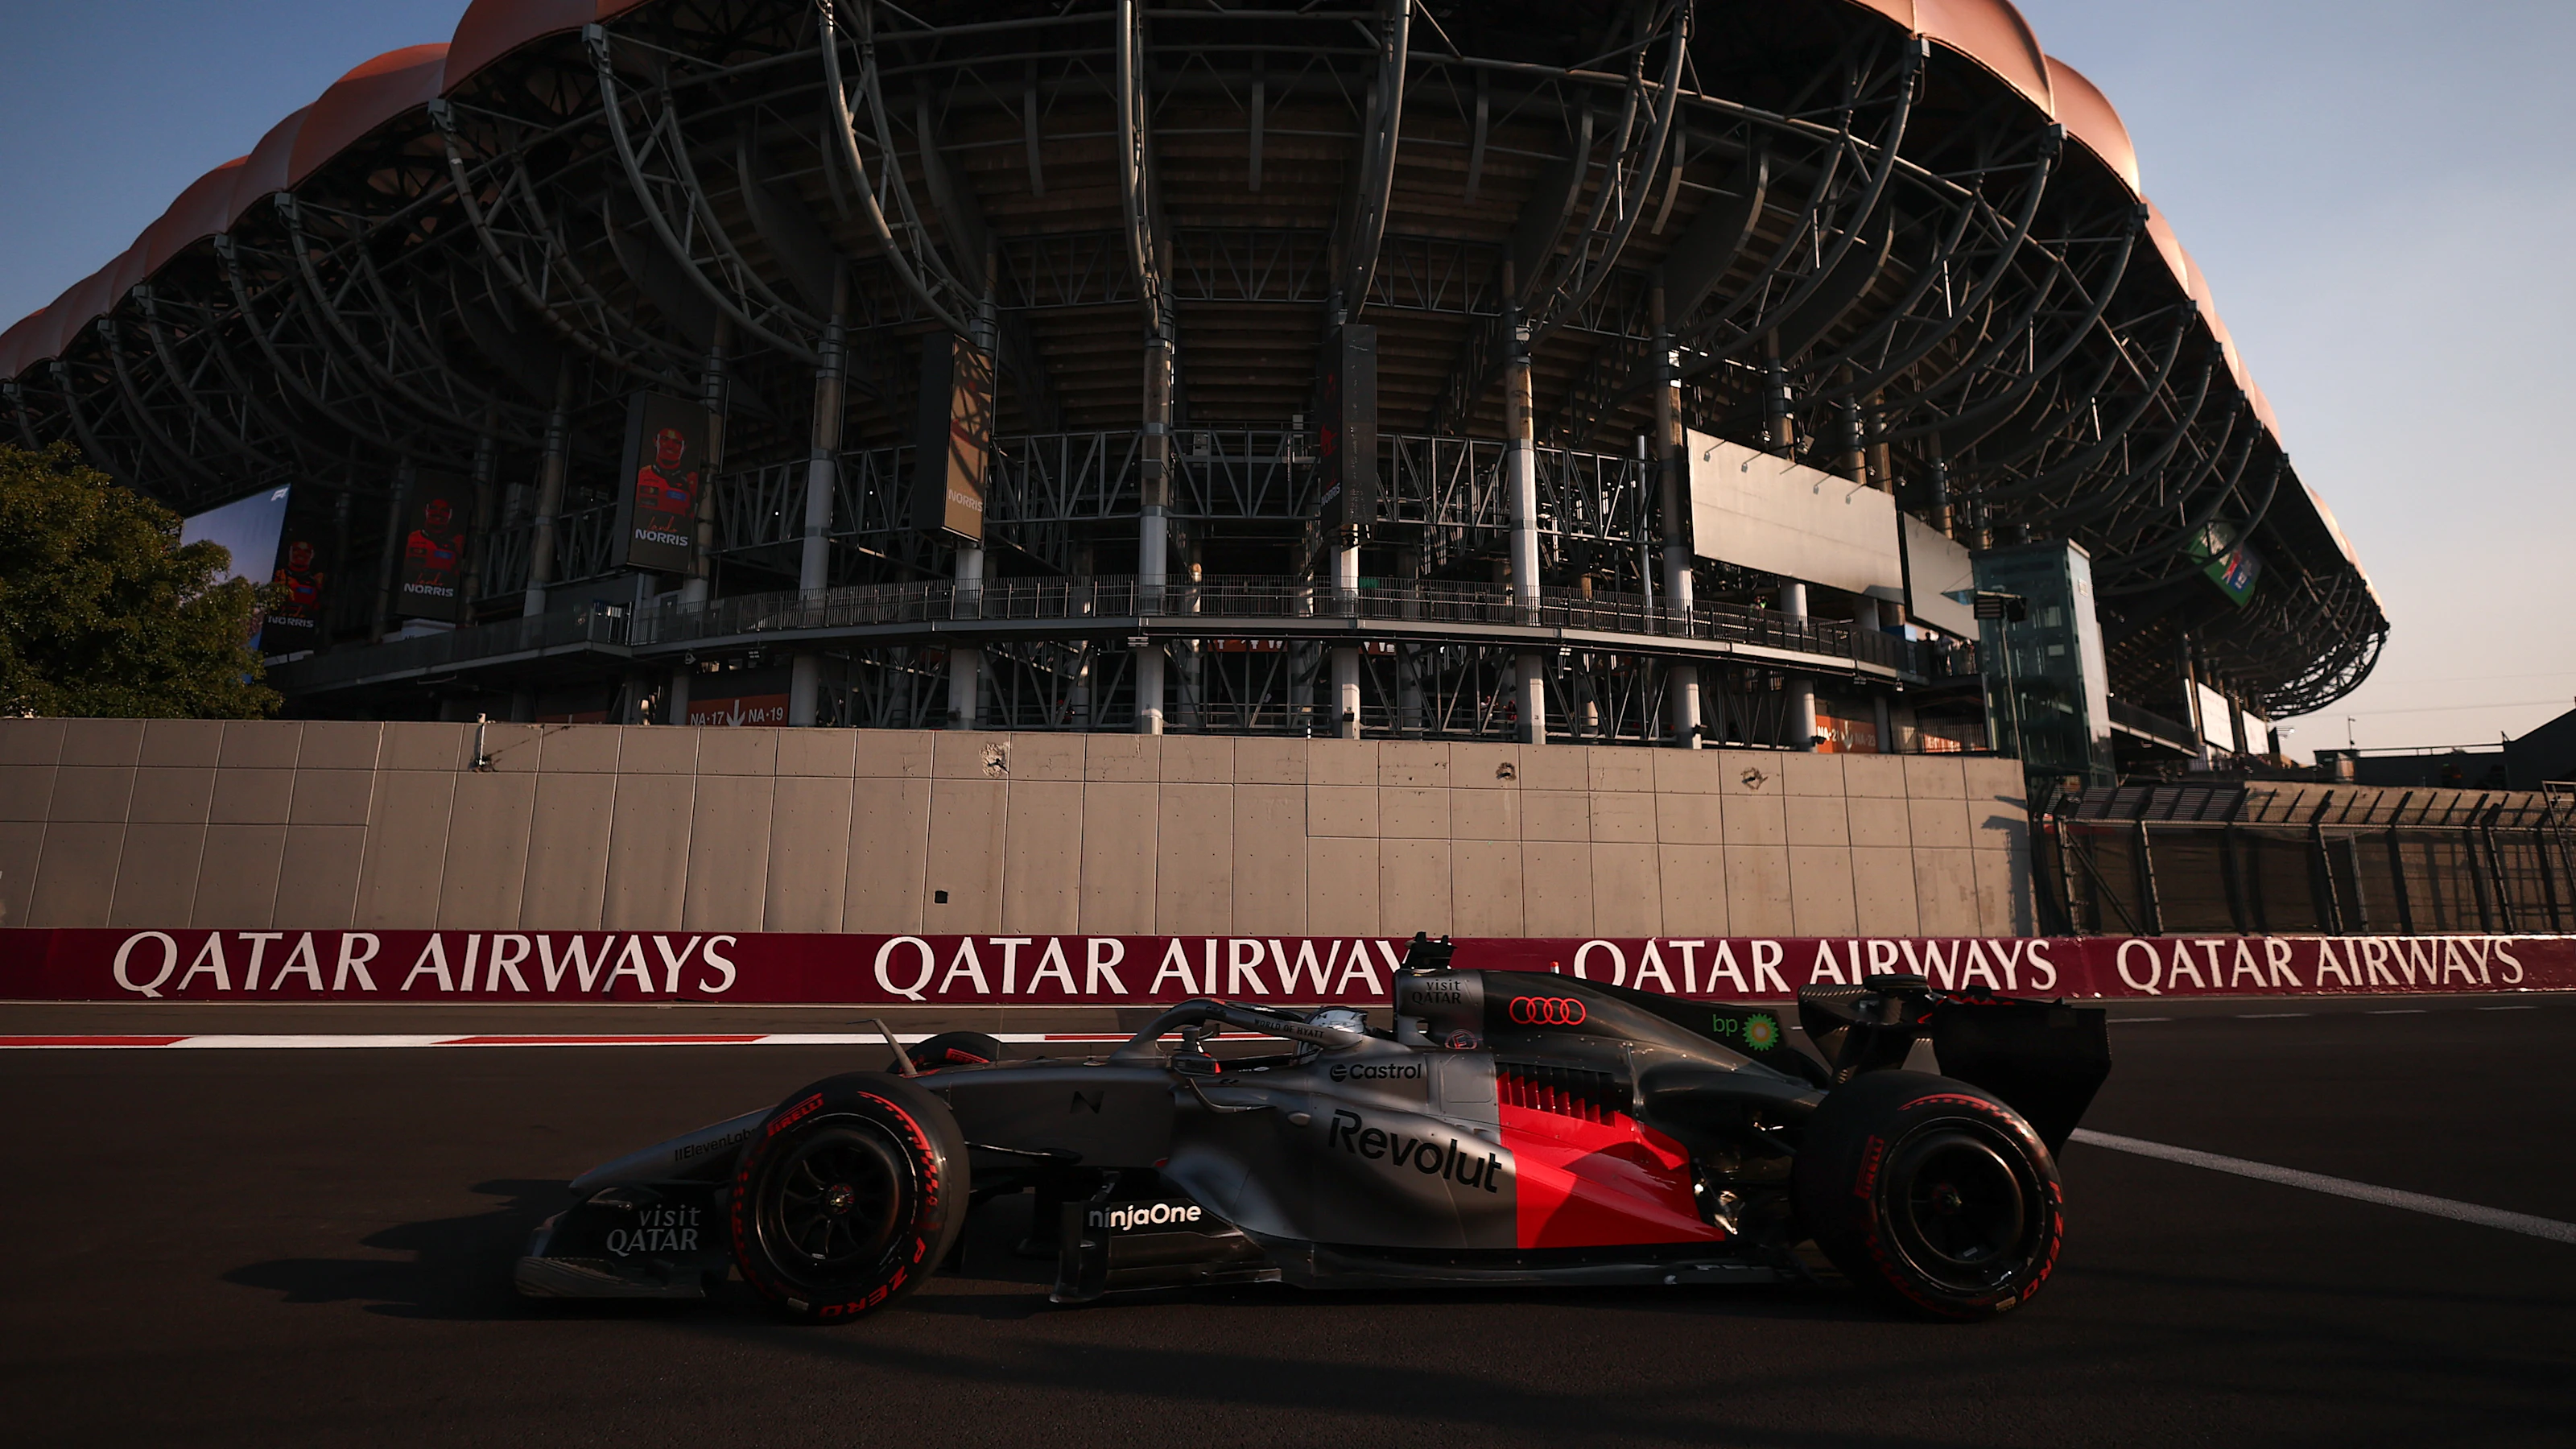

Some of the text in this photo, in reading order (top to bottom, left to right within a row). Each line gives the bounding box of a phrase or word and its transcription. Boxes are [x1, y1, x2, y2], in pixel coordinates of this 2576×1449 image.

[948, 489, 984, 512] NORRIS
[634, 528, 688, 547] NORRIS
[403, 583, 454, 597] NORRIS
[267, 614, 315, 629] NORRIS
[114, 931, 737, 997] QATAR AIRWAYS
[874, 936, 1410, 1001] QATAR AIRWAY
[1574, 939, 2058, 993] QATAR AIRWAYS
[2116, 938, 2524, 995] QATAR AIRWAYS
[1426, 980, 1461, 991] visit
[1412, 992, 1461, 1005] QATAR
[1254, 1018, 1324, 1038] WORLD OF HYATT
[1712, 1013, 1739, 1037] bp
[1349, 1063, 1422, 1080] Castrol
[766, 1092, 825, 1137] PIRELLI
[1329, 1108, 1502, 1194] Revolut
[639, 1203, 701, 1227] visit
[1088, 1203, 1202, 1232] ninjaOne
[605, 1228, 699, 1257] QATAR
[819, 1265, 909, 1318] ZERO
